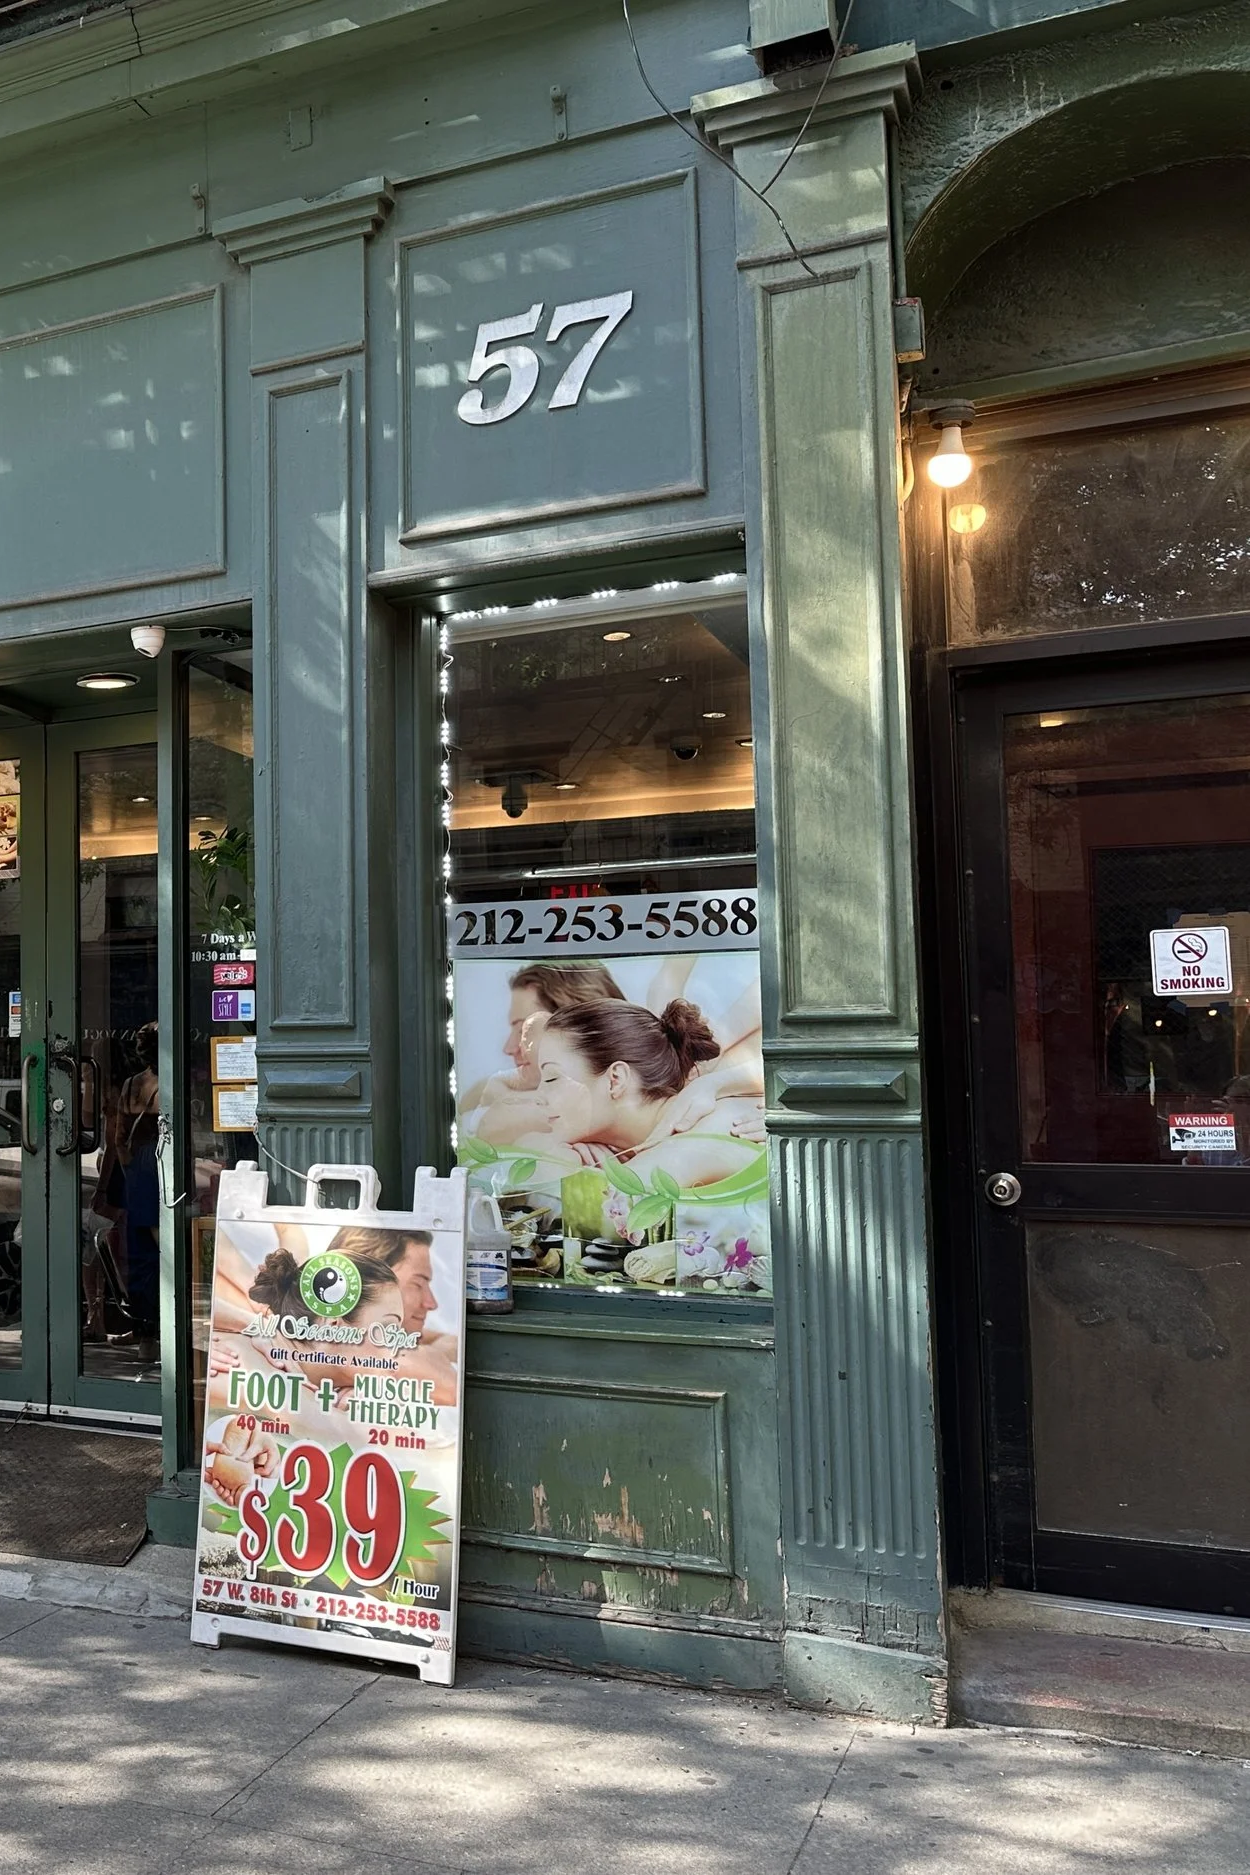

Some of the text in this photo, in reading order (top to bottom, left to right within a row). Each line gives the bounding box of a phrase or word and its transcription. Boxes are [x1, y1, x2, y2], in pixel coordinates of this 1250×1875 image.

[457, 290, 633, 425] 57
[454, 896, 758, 947] 212-253-5588
[201, 933, 208, 945] 7
[210, 932, 236, 946] Days
[238, 934, 245, 943] a
[191, 950, 218, 962] 10:30
[1182, 965, 1201, 977] NO
[1160, 976, 1225, 990] SMOKING
[218, 1003, 233, 1017] STYLE
[1174, 1116, 1228, 1126] WARNING
[1197, 1129, 1234, 1138] 24 HOURS
[302, 1256, 359, 1291] ALL SEASONS
[311, 1301, 348, 1314] SPA
[241, 1313, 422, 1356] All Seasons Spa
[270, 1347, 399, 1370] Gift Certificate Available
[228, 1369, 305, 1412] FOOT
[354, 1376, 434, 1405] MUSCLE
[348, 1399, 441, 1431] THERAPY
[236, 1416, 291, 1435] 40 min
[368, 1429, 426, 1450] 20 min
[201, 1578, 442, 1632] 57 W. 8th St 212-253-5588
